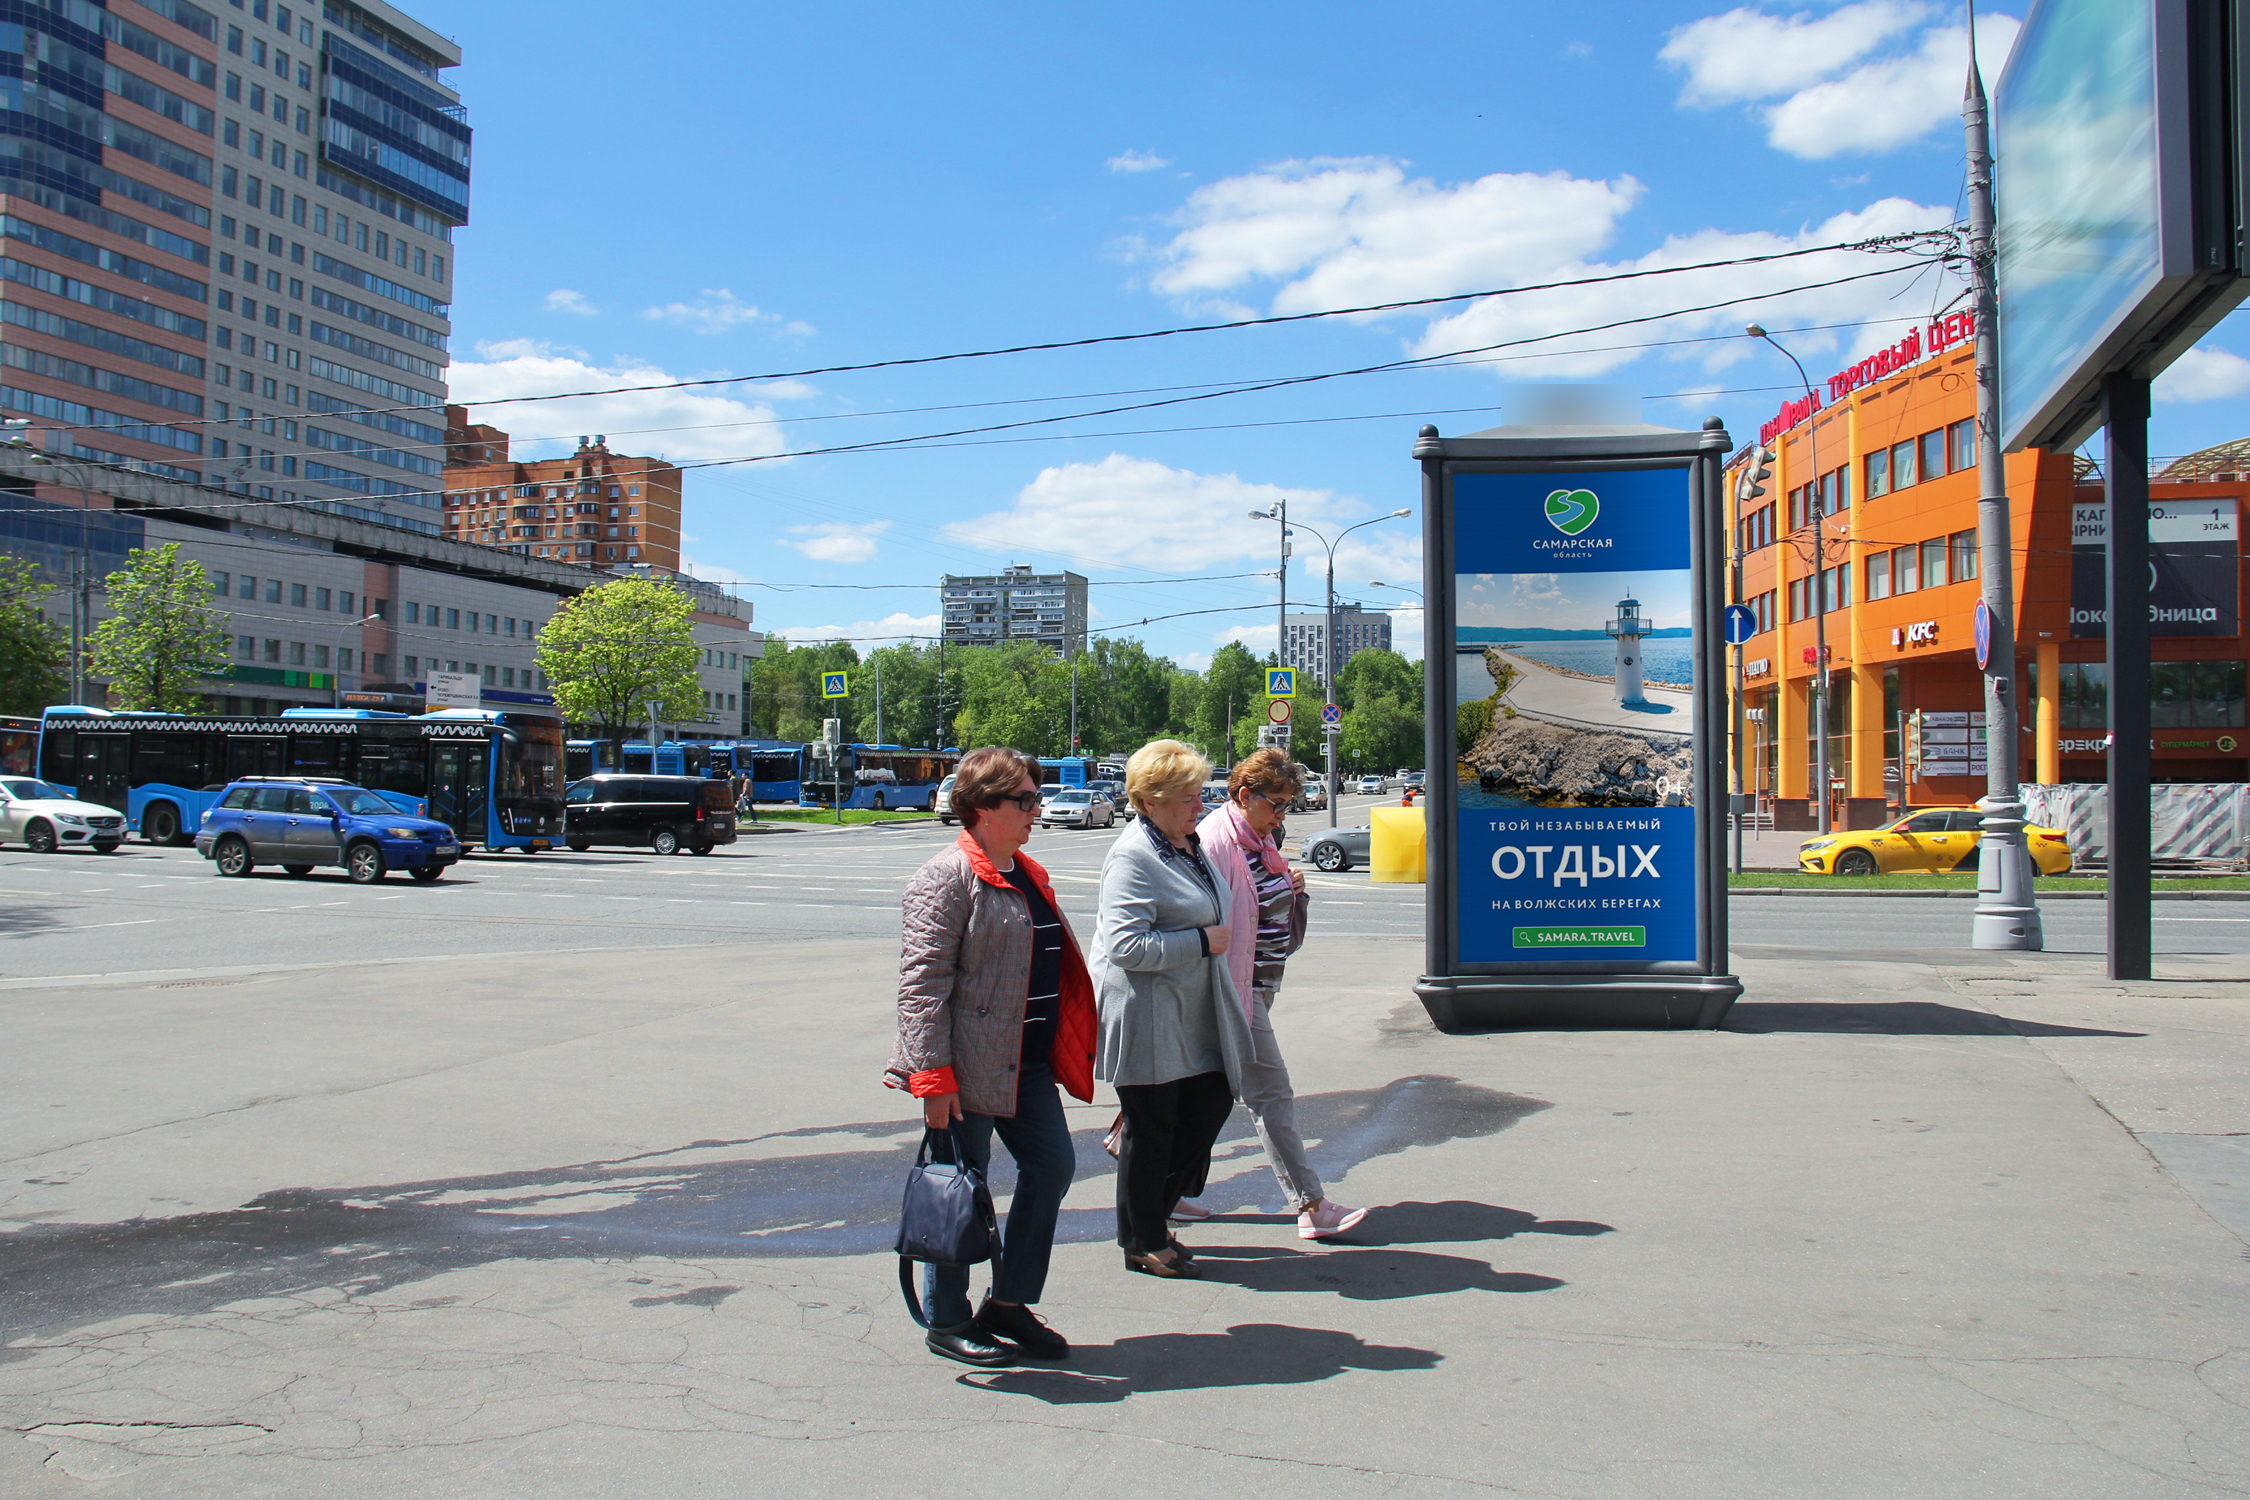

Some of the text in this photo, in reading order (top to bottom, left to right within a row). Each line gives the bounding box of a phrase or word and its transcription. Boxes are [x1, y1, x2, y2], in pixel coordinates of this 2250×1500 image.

[1827, 326, 1920, 402] ТОРГОВЫЙ
[2211, 508, 2219, 521] 1
[2202, 523, 2230, 531] ЭТАЖ
[1532, 538, 1613, 550] САМАРСКАЯ
[1553, 551, 1592, 559] область
[1907, 621, 1937, 642] KFC
[1655, 776, 1687, 796] 0+
[1489, 818, 1661, 831] ТВОЙ НЕЗАБЫВАЕМЫЙ
[1491, 845, 1661, 888] ОТДЫХ
[1492, 898, 1661, 910] НА ВОЛЖСКИХ БЕРЕГАХ
[1537, 932, 1635, 942] SAMARA.TRAVEL
